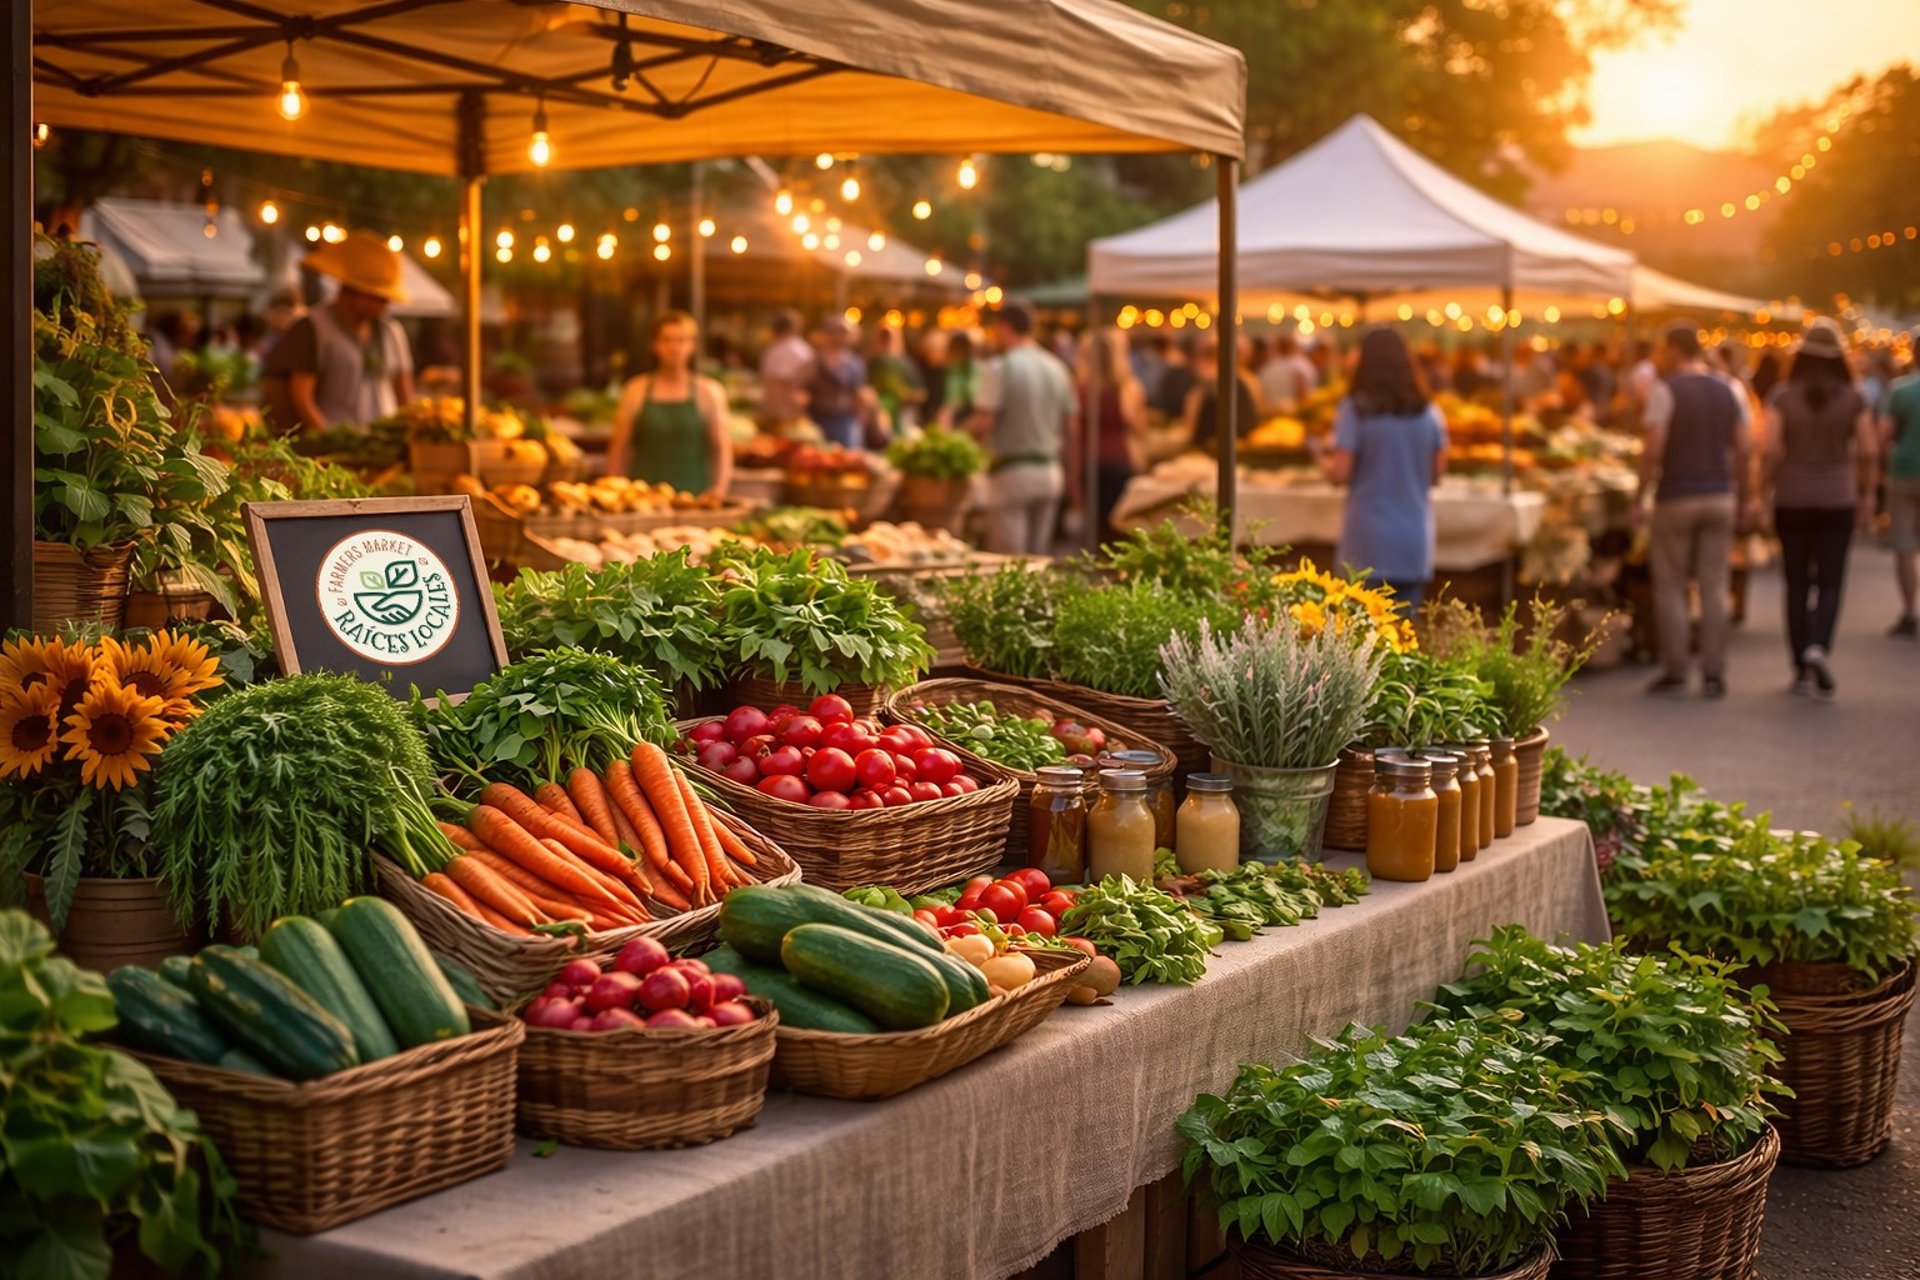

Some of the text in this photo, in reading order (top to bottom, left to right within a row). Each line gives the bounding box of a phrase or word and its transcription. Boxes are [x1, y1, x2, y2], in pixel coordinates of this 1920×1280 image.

[328, 538, 414, 593] FARMERS MARKET
[334, 572, 451, 654] RAÍCES LOCALES
